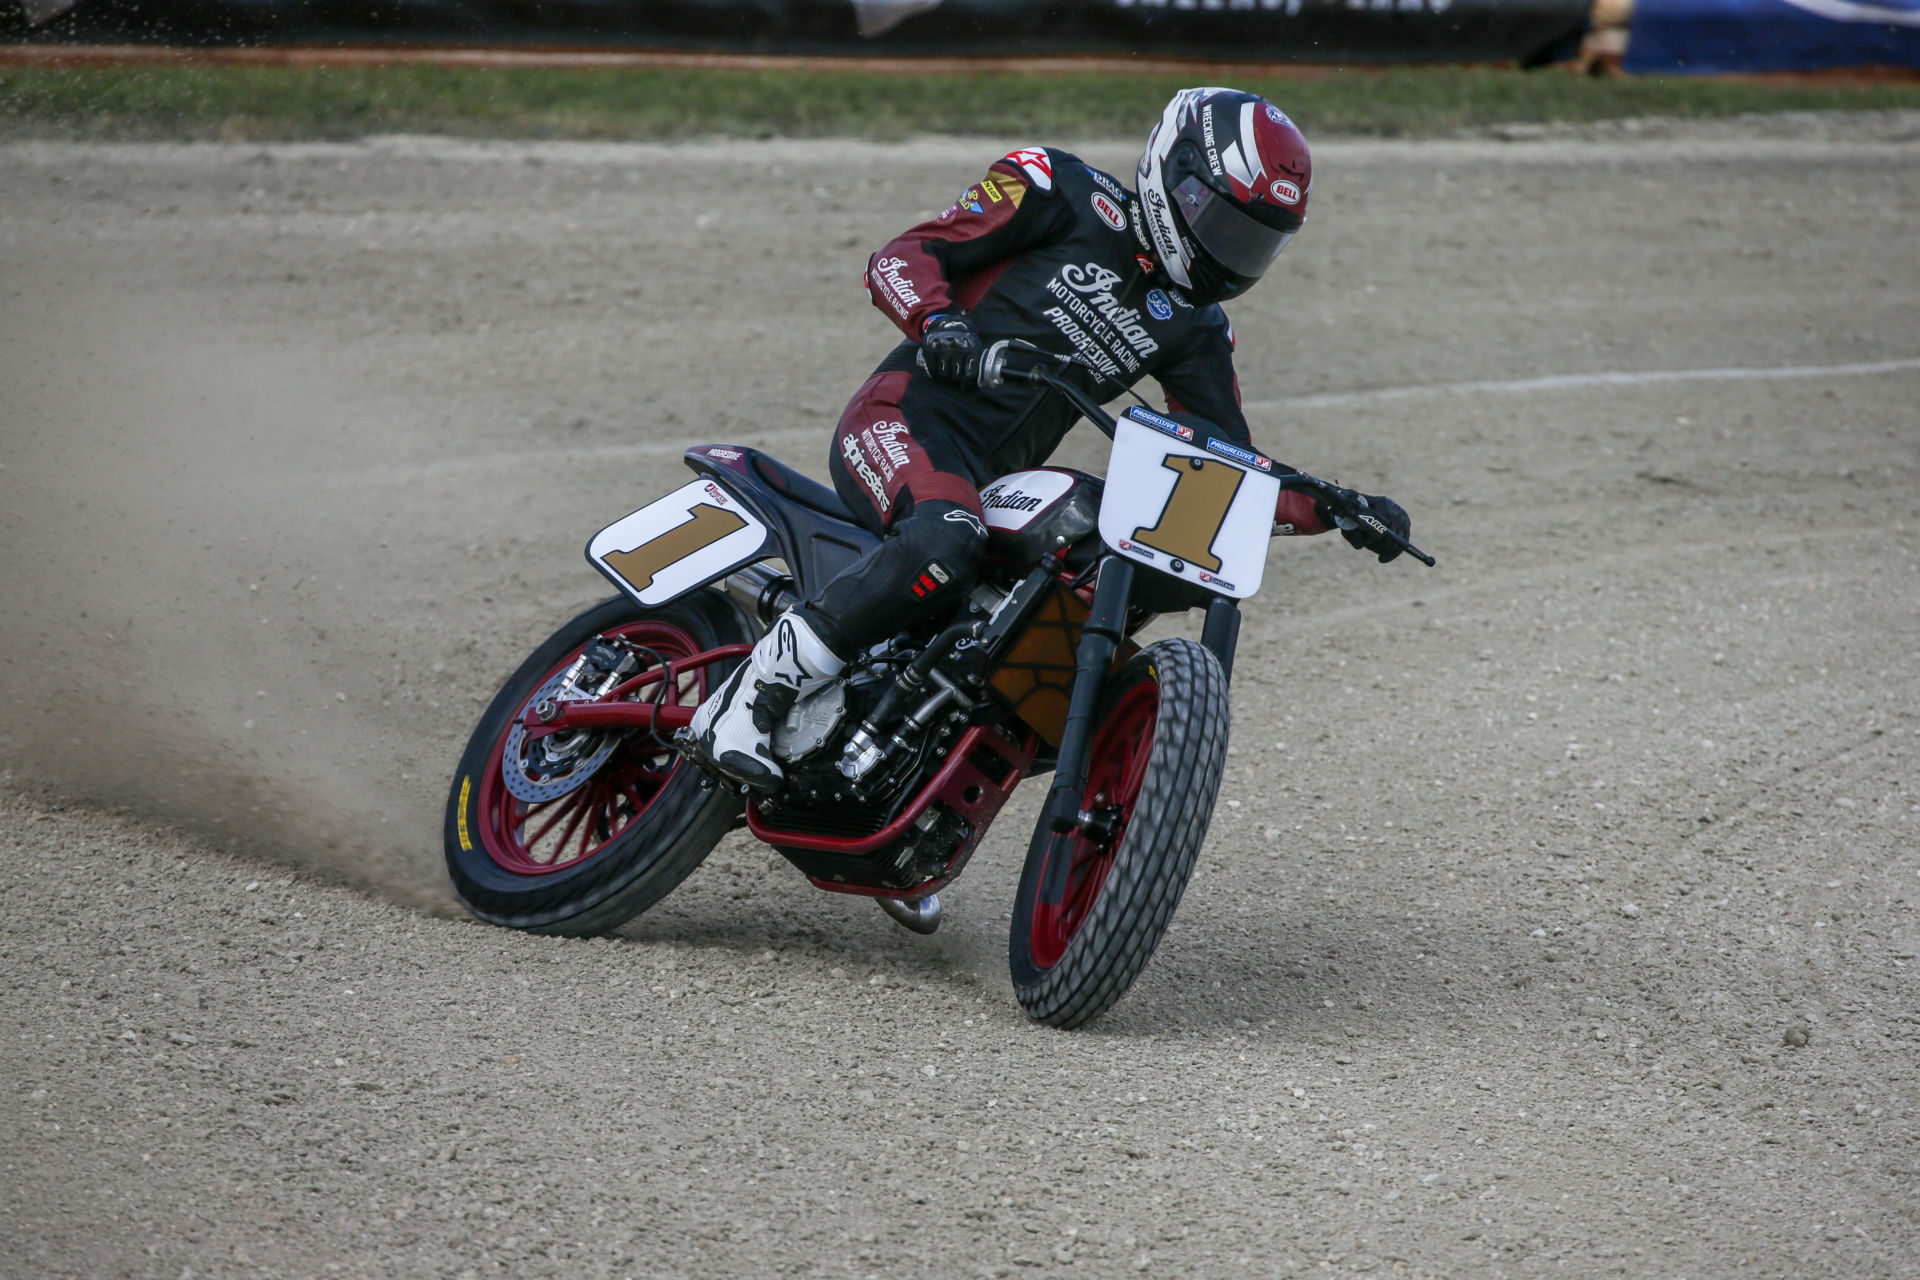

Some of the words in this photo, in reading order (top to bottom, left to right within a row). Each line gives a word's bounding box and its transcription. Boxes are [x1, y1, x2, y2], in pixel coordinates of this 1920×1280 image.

[1203, 104, 1215, 148] WRECKING
[1207, 148, 1222, 176] CREW
[1096, 197, 1120, 226] BELL
[1276, 184, 1298, 200] BELL
[1143, 192, 1159, 235] MOTORCYCLE
[1156, 235, 1170, 260] RACING
[1148, 188, 1178, 256] Indian
[871, 267, 894, 303] MOTORCYCLE
[891, 297, 909, 320] RACING
[877, 257, 921, 308] Indian
[1151, 293, 1169, 315] S&S
[1046, 277, 1115, 344] MOTORCYCLE
[1110, 338, 1140, 374] RACING
[1062, 262, 1159, 358] Indian
[1043, 306, 1121, 377] PROGRESSIVE
[1132, 408, 1176, 430] PROGRESSIVE
[861, 427, 881, 465] MOTORCYCLE
[872, 420, 910, 469] Indian
[1209, 440, 1254, 461] PROGRESSIVE
[842, 433, 891, 513] alpinestars
[982, 484, 1043, 513] Indian
[1130, 453, 1248, 575] 1
[600, 502, 750, 593] 1
[1358, 514, 1388, 534] ARC
